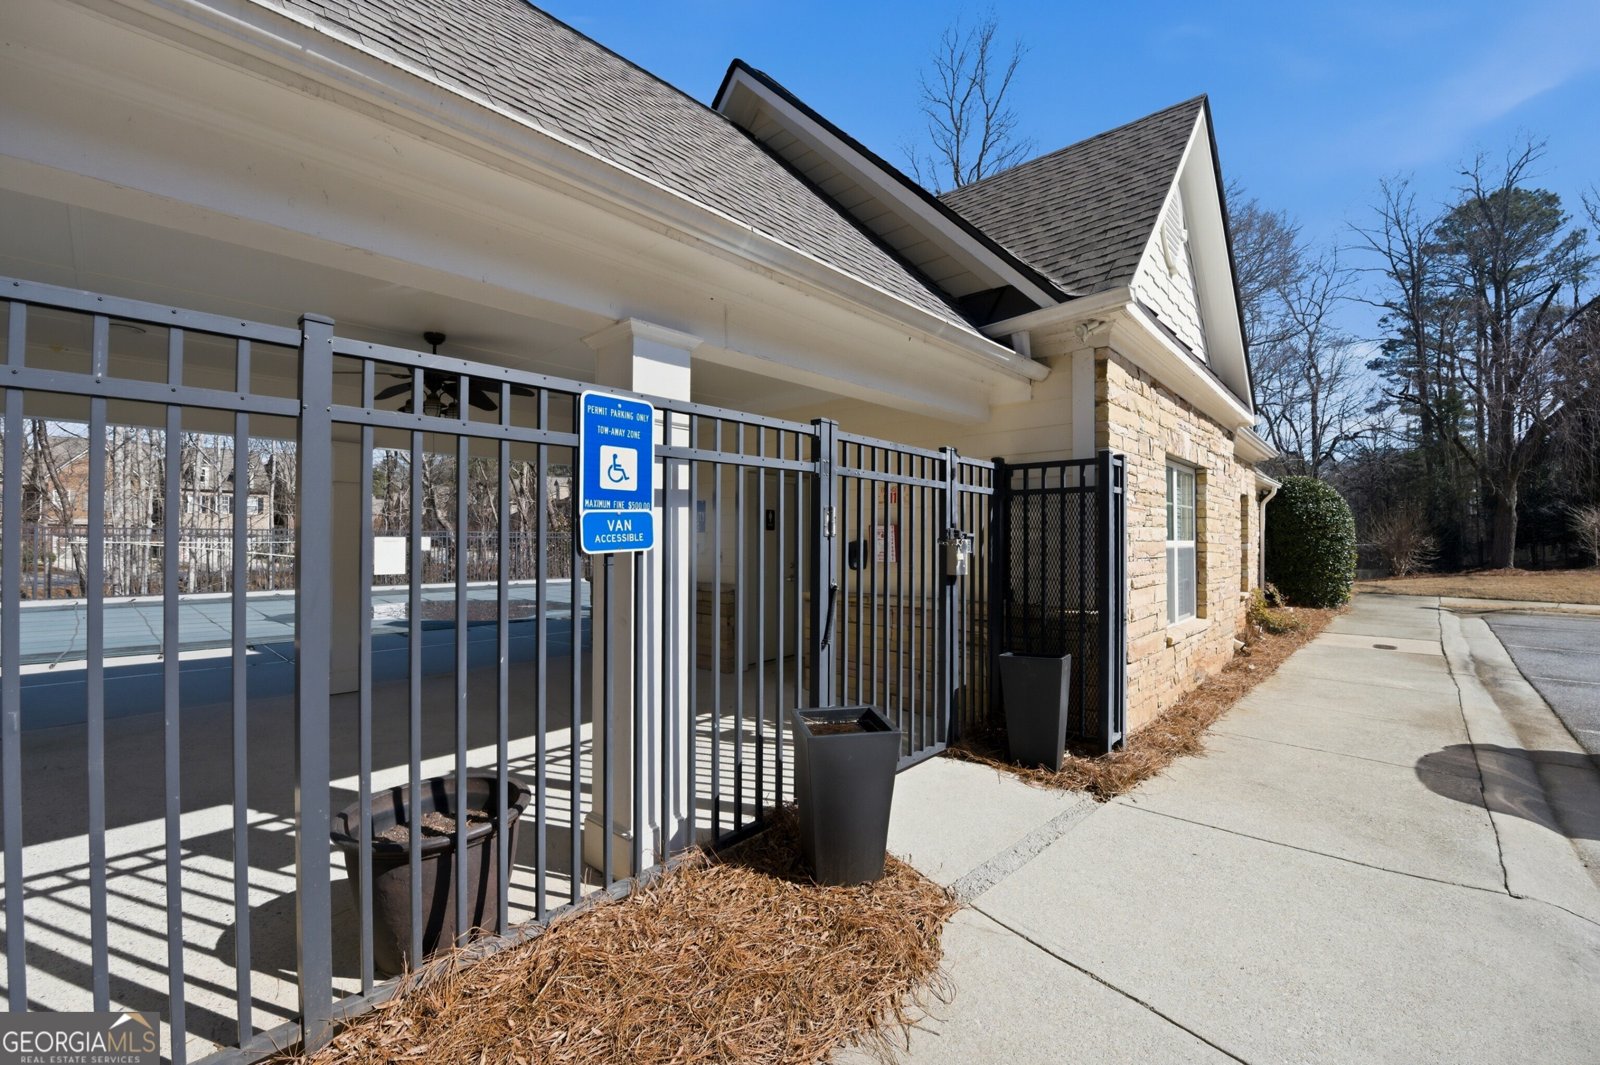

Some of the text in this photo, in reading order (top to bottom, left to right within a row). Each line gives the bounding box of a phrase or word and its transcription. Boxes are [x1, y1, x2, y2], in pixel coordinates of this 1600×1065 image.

[587, 404, 650, 423] PERMIT PARKING ONLY
[597, 425, 641, 440] TOW-AWAY ZONE
[584, 498, 651, 510] MAXIMUM FINE $500.00
[606, 519, 632, 532] VAN
[594, 532, 644, 544] ACCESSIBLE
